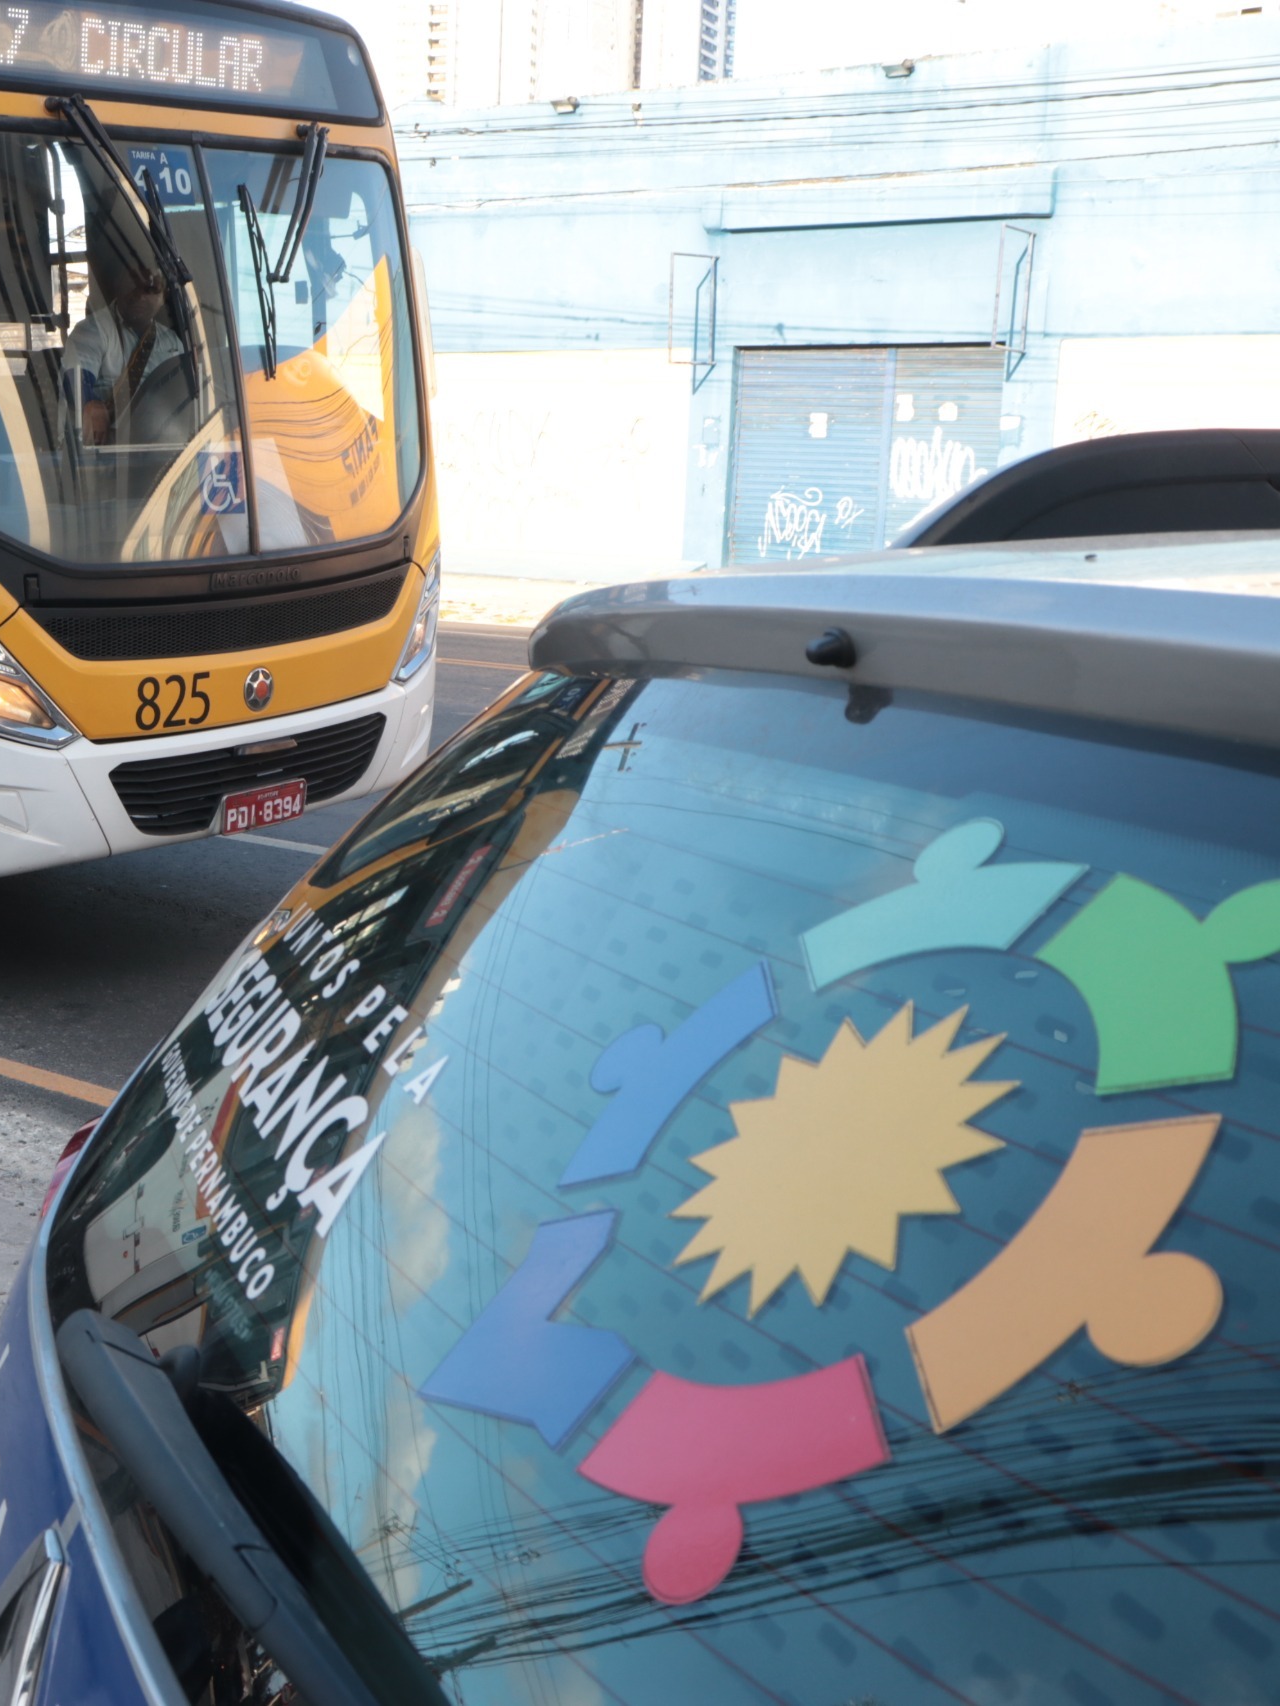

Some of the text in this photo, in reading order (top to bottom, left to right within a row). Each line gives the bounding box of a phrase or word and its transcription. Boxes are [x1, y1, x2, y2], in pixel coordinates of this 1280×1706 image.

[80, 17, 264, 92] CIRCULAR
[131, 150, 169, 165] TARIFA A
[215, 566, 300, 588] Marcopolo
[135, 671, 210, 731] 825
[274, 901, 449, 1105] JUNTOS PELA
[161, 1041, 192, 1117] GOVERNO
[204, 948, 388, 1239] SEGURANÇA
[175, 1102, 202, 1144] DE
[184, 1129, 275, 1300] PERNAMBUCO
